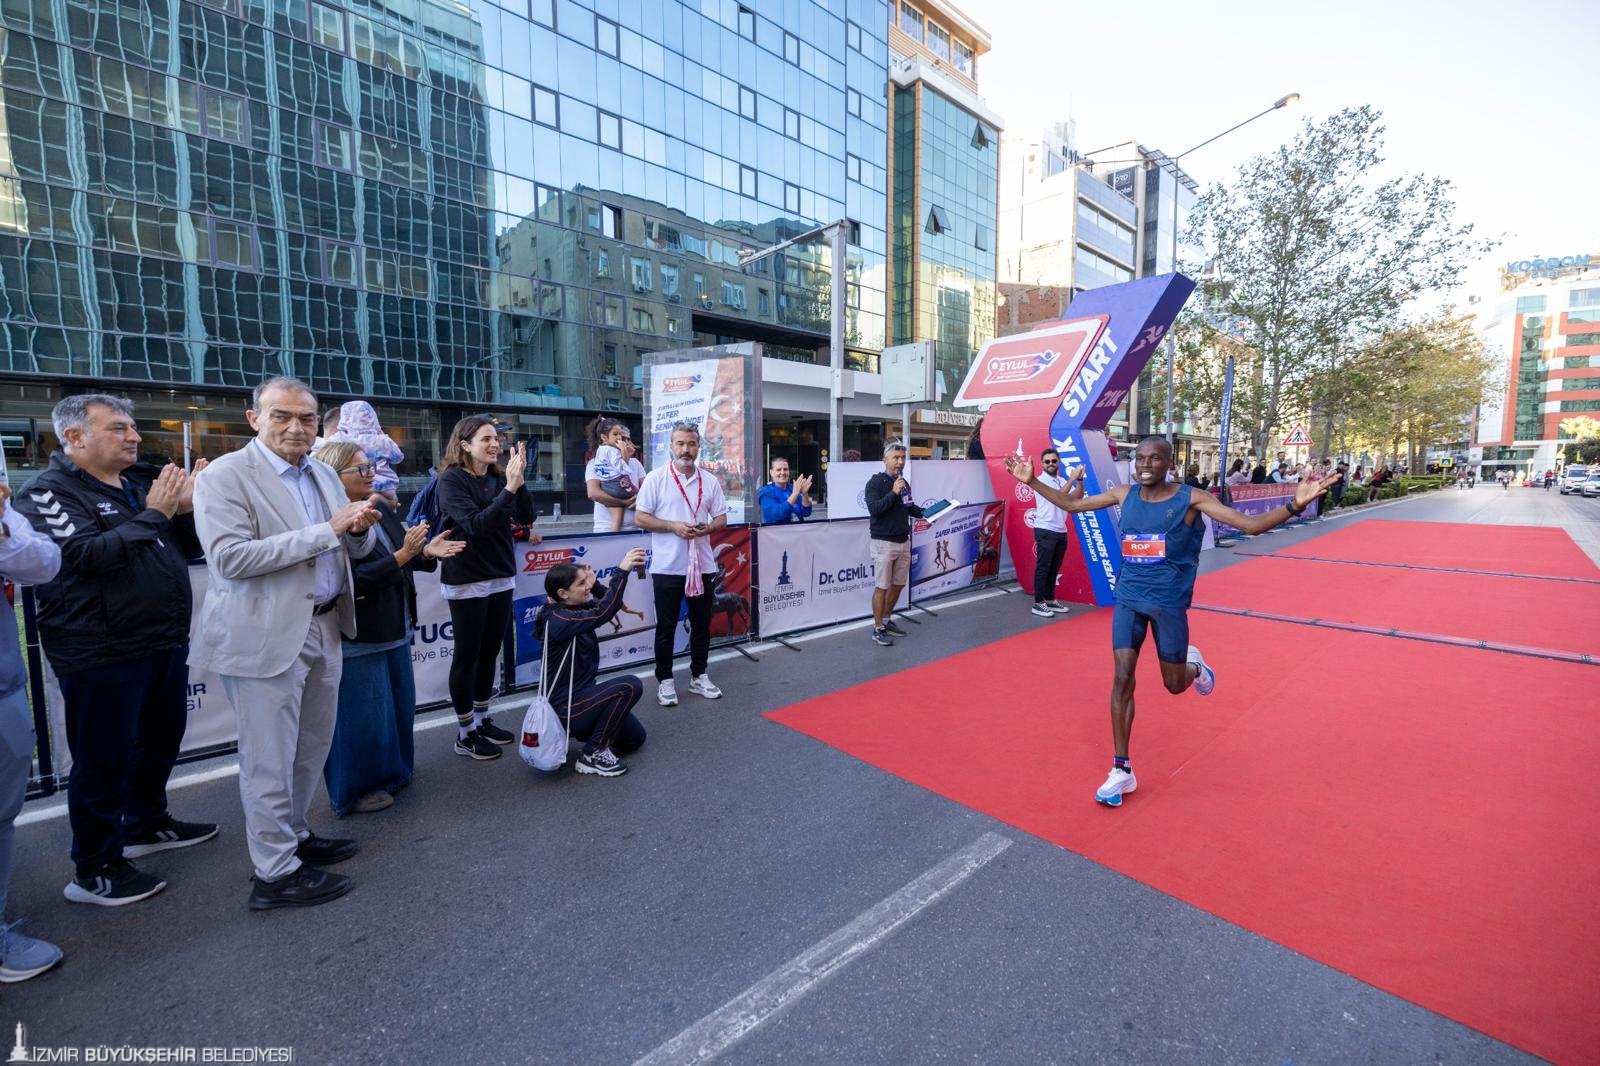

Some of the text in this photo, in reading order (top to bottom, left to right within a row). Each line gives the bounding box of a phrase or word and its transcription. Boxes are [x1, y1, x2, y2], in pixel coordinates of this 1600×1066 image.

[1507, 254, 1590, 273] KORDON
[1062, 327, 1118, 418] START
[1094, 389, 1127, 408] 21K
[657, 410, 679, 420] ZAFER
[935, 528, 951, 539] ZAFER
[1091, 529, 1109, 558] SENİN
[536, 551, 566, 562] EYLÜL
[819, 571, 835, 586] Dr.
[837, 563, 868, 582] CEMİL
[411, 650, 437, 662] diye
